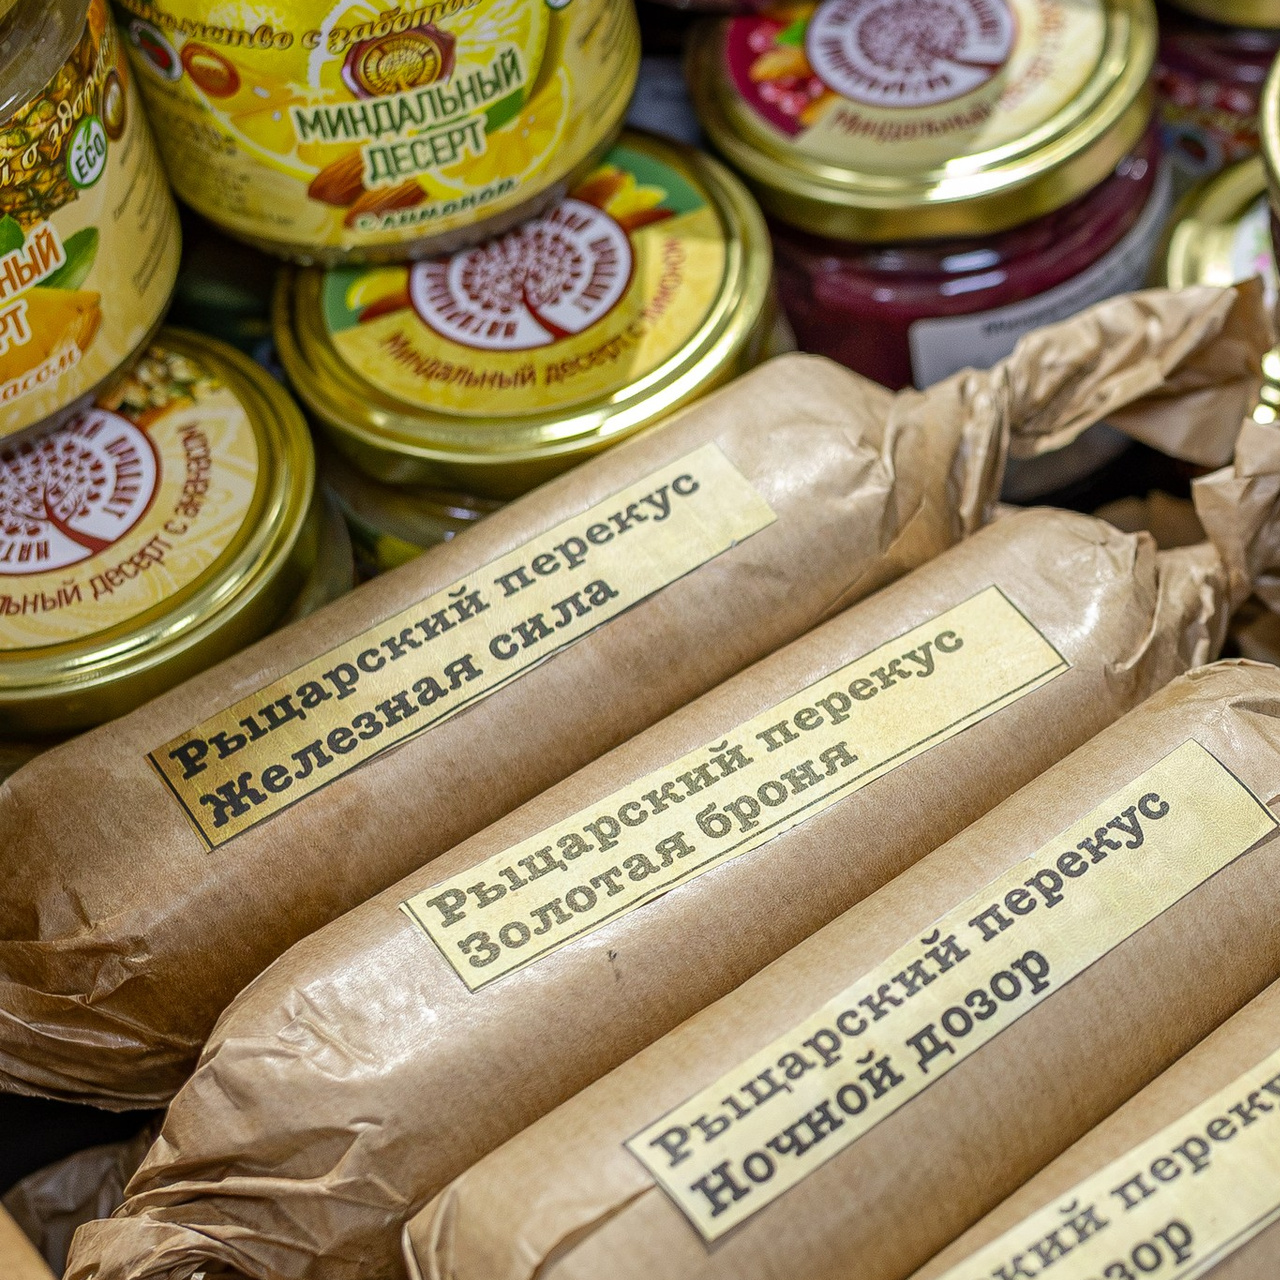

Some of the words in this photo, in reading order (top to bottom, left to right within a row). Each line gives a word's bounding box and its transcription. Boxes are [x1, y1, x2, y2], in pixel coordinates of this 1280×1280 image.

[75, 133, 106, 183] ECO
[295, 47, 523, 141] МИНДАЛЬНЫЙ
[368, 120, 484, 185] ДЕСЕРТ
[380, 329, 538, 390] Миндальный
[544, 334, 631, 386] десерт
[89, 533, 173, 601] десерт
[163, 520, 188, 535] с
[169, 585, 491, 781] Рыцарский
[494, 470, 702, 596] перекус
[200, 653, 483, 828] Железная
[489, 578, 620, 662] сила
[426, 739, 755, 929] Рыцарский
[756, 625, 965, 753] перекус
[457, 835, 696, 970] Золотая
[695, 740, 859, 840] броня
[649, 929, 971, 1170] Рыцарский
[968, 790, 1172, 942] перекус
[690, 1050, 905, 1220] Ночной
[905, 946, 1053, 1075] дозор
